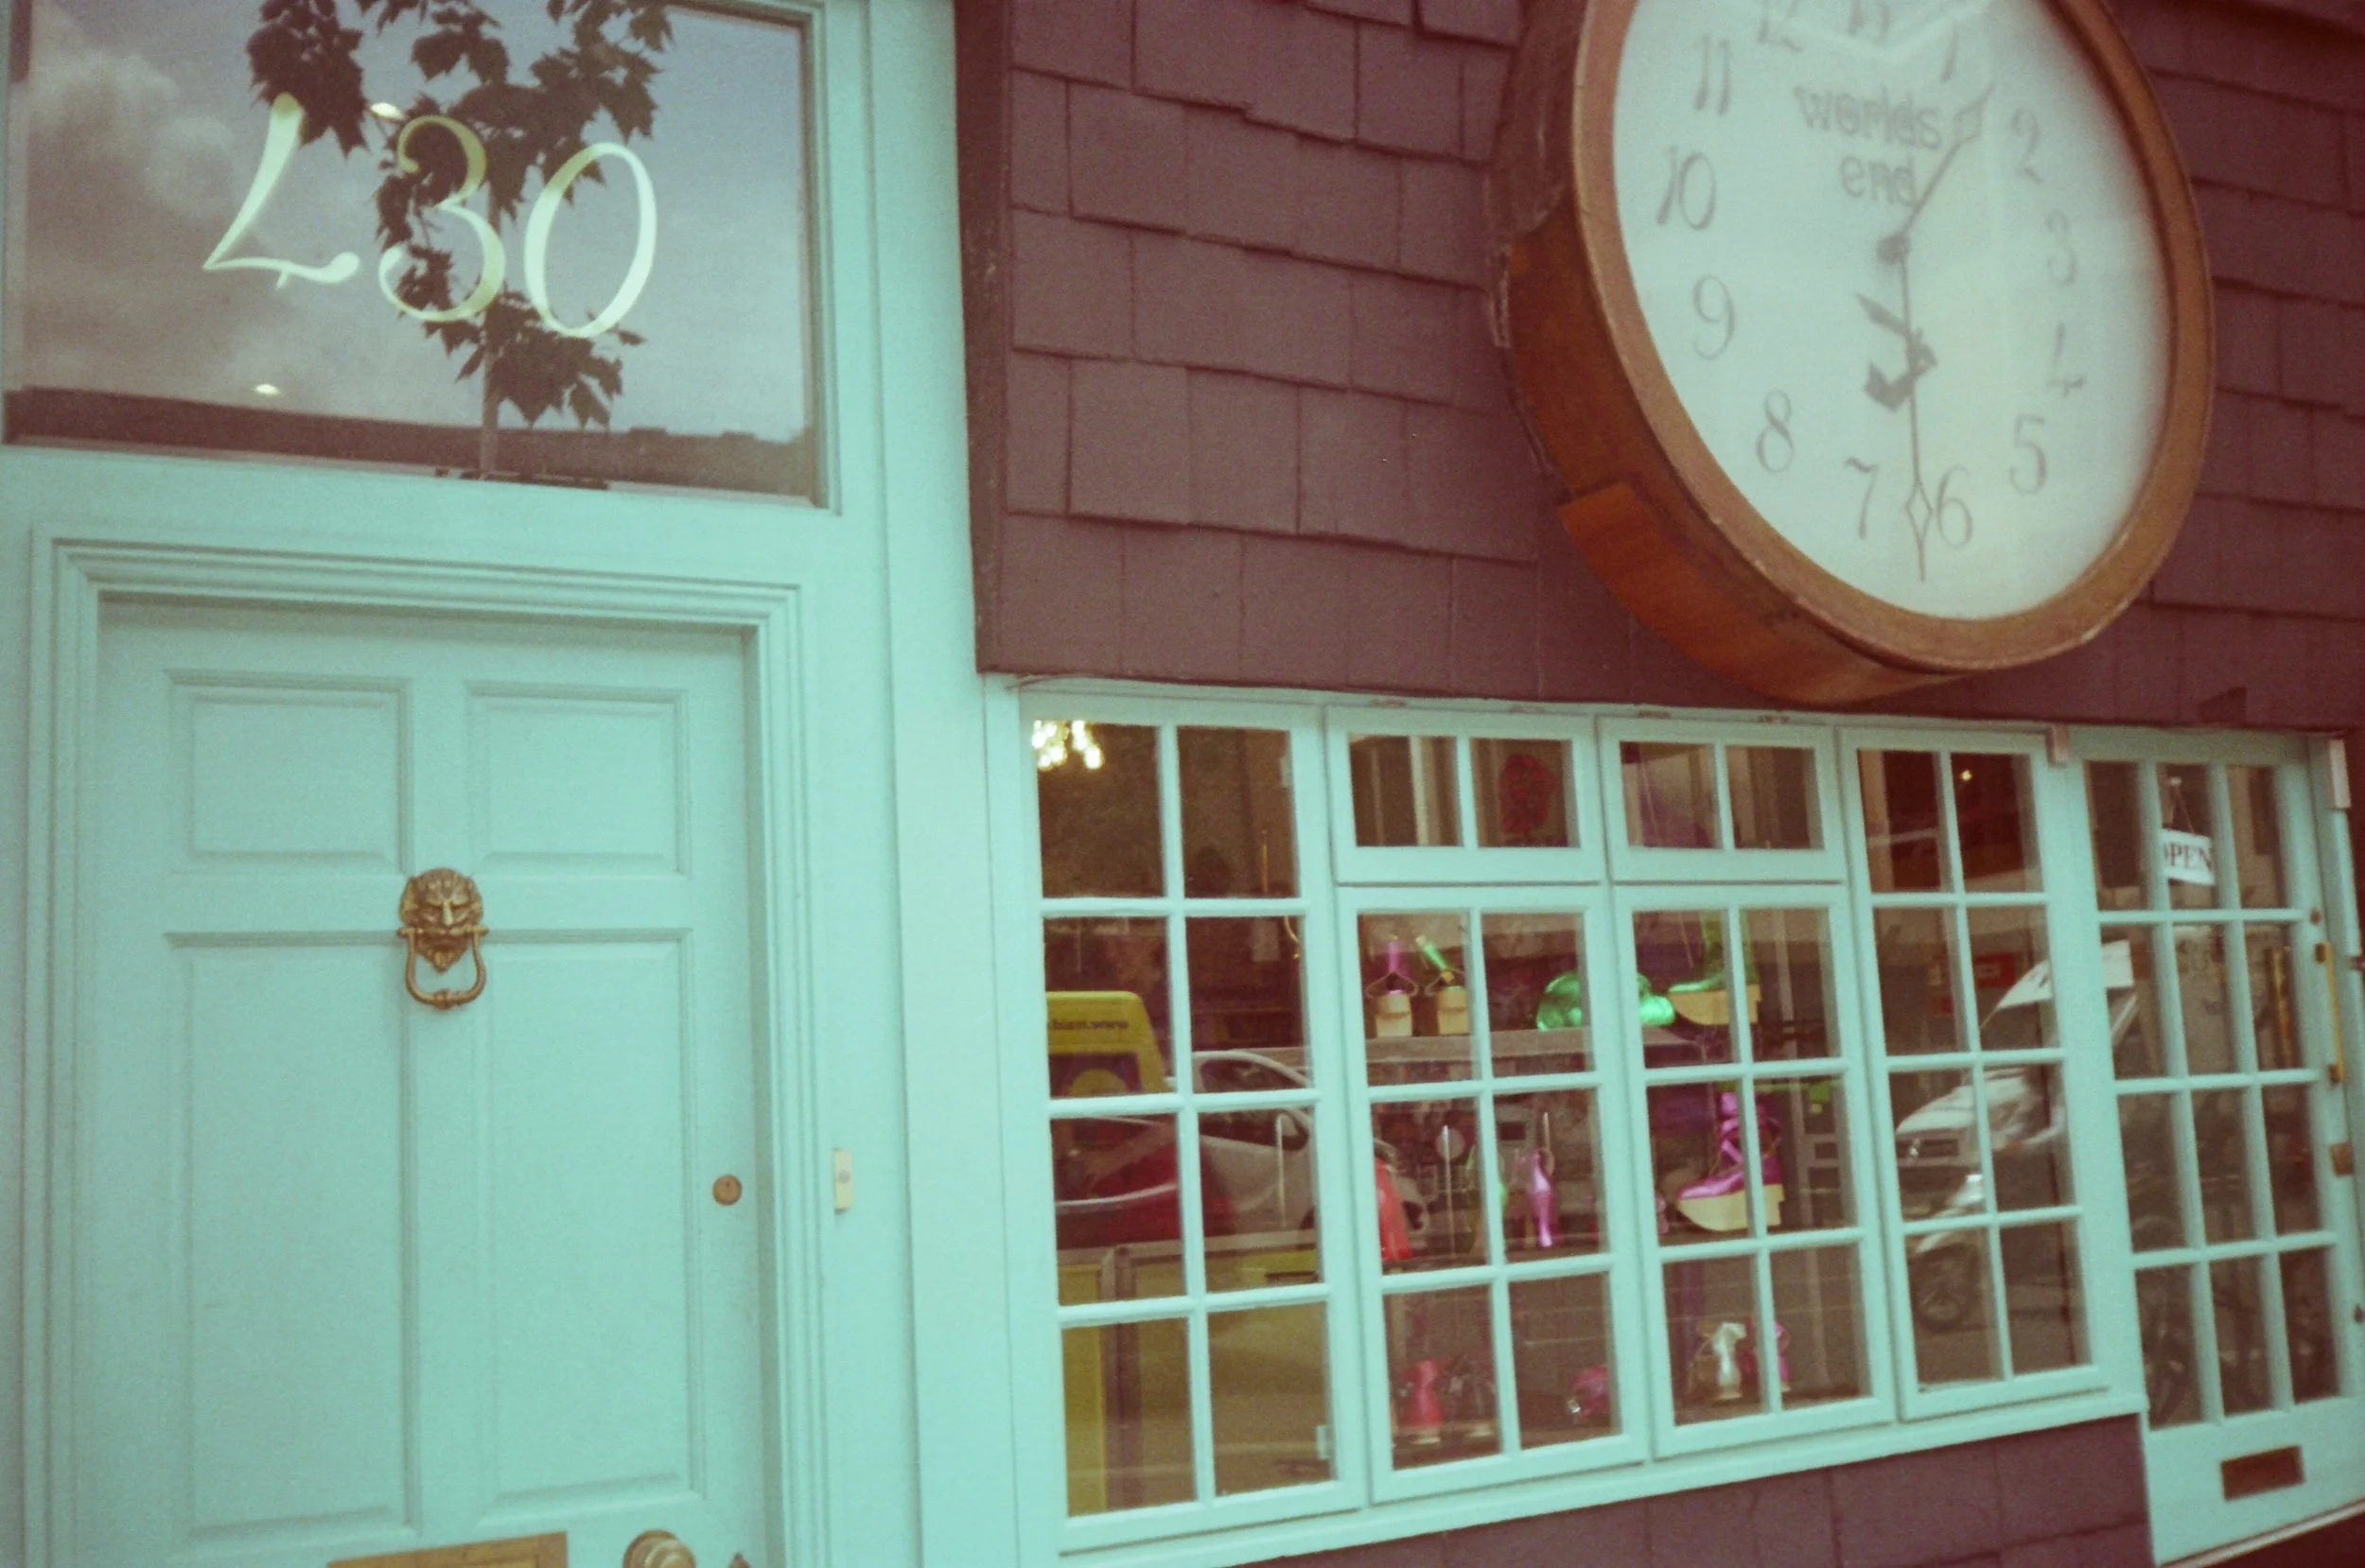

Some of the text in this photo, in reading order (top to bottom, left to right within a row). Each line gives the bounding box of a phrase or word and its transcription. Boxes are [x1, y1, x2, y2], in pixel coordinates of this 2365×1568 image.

[1692, 33, 1732, 116] 11
[1793, 86, 1943, 149] worlds
[2009, 107, 2043, 184] 2
[202, 92, 657, 339] 430
[1656, 145, 1718, 232] 10
[1838, 155, 1918, 207] end
[2043, 209, 2078, 287] 3
[1691, 273, 1737, 361] 9
[2046, 322, 2088, 398] 4
[1754, 389, 1796, 474] 8
[2008, 413, 2049, 496] 5
[1844, 455, 1881, 540] 7
[1935, 464, 1974, 550] 6
